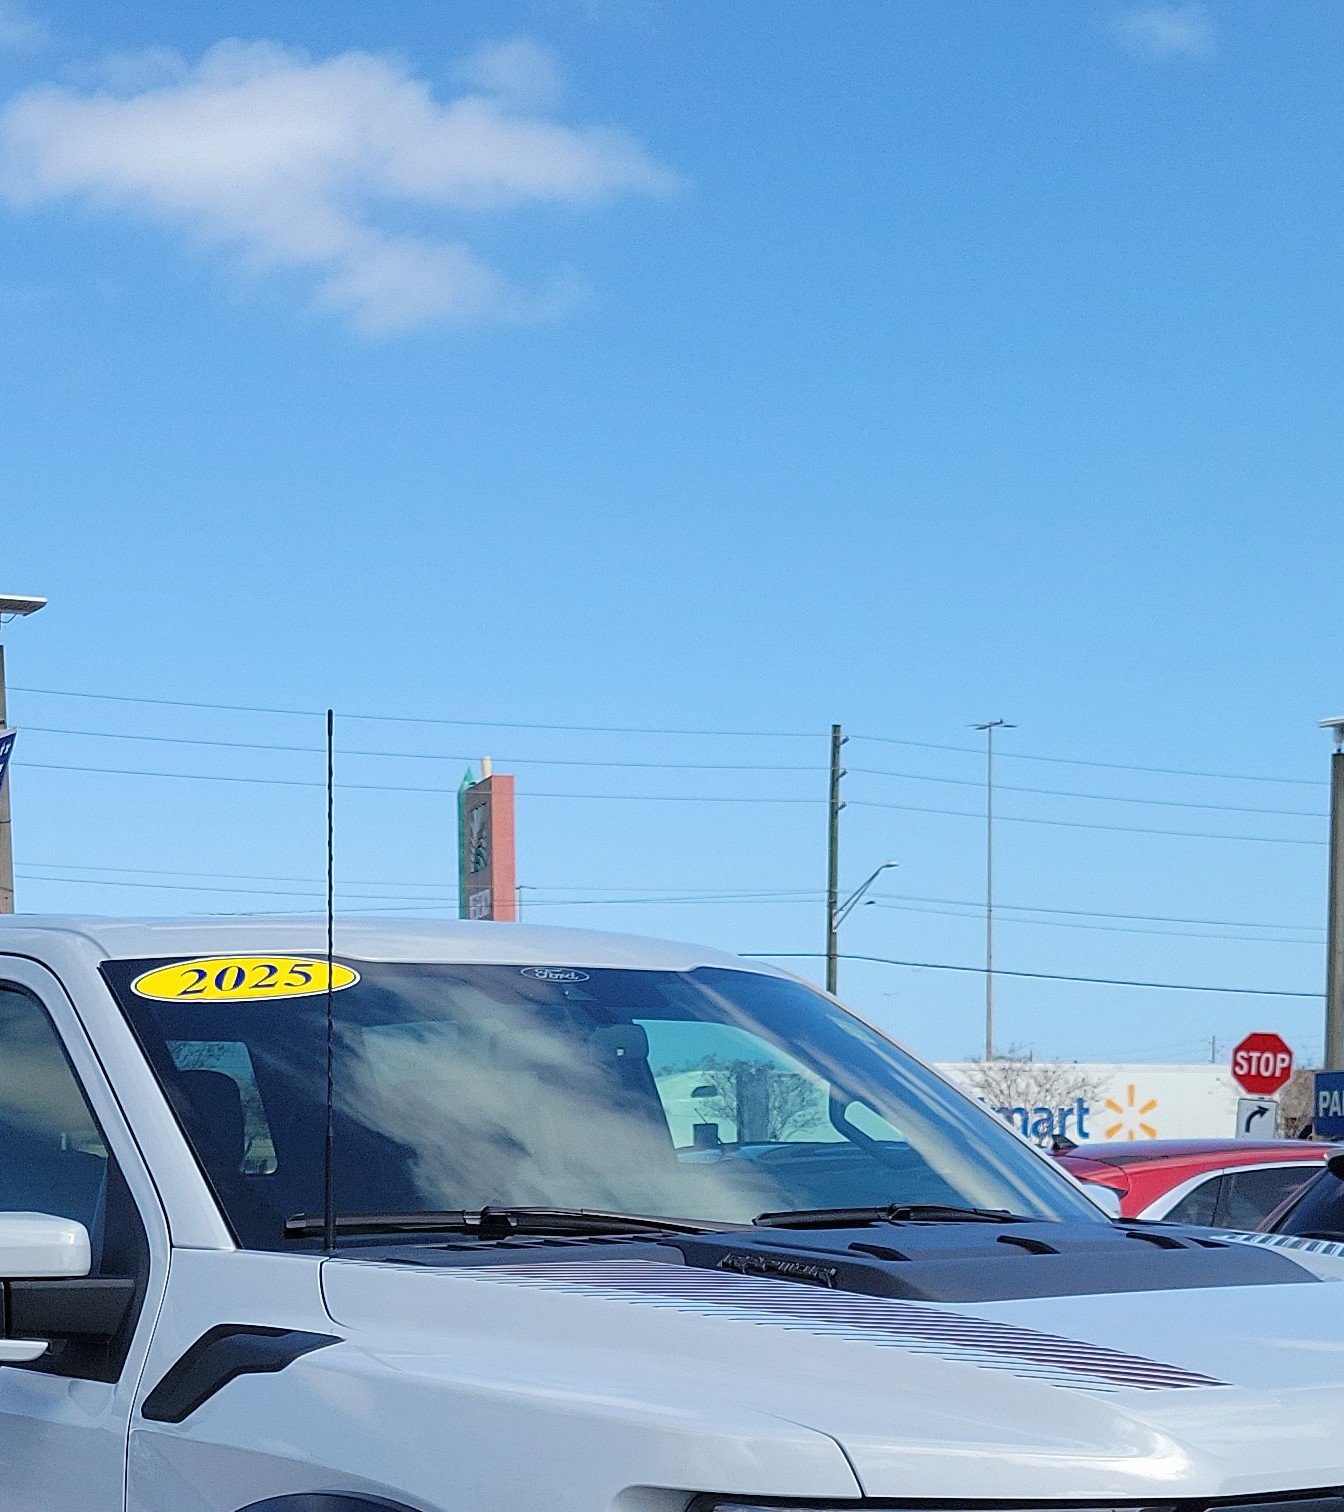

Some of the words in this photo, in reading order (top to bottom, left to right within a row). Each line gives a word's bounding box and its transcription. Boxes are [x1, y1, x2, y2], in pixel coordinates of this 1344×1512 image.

[175, 962, 314, 997] 2025
[1234, 1050, 1292, 1078] STOP
[978, 1097, 1090, 1140] mart
